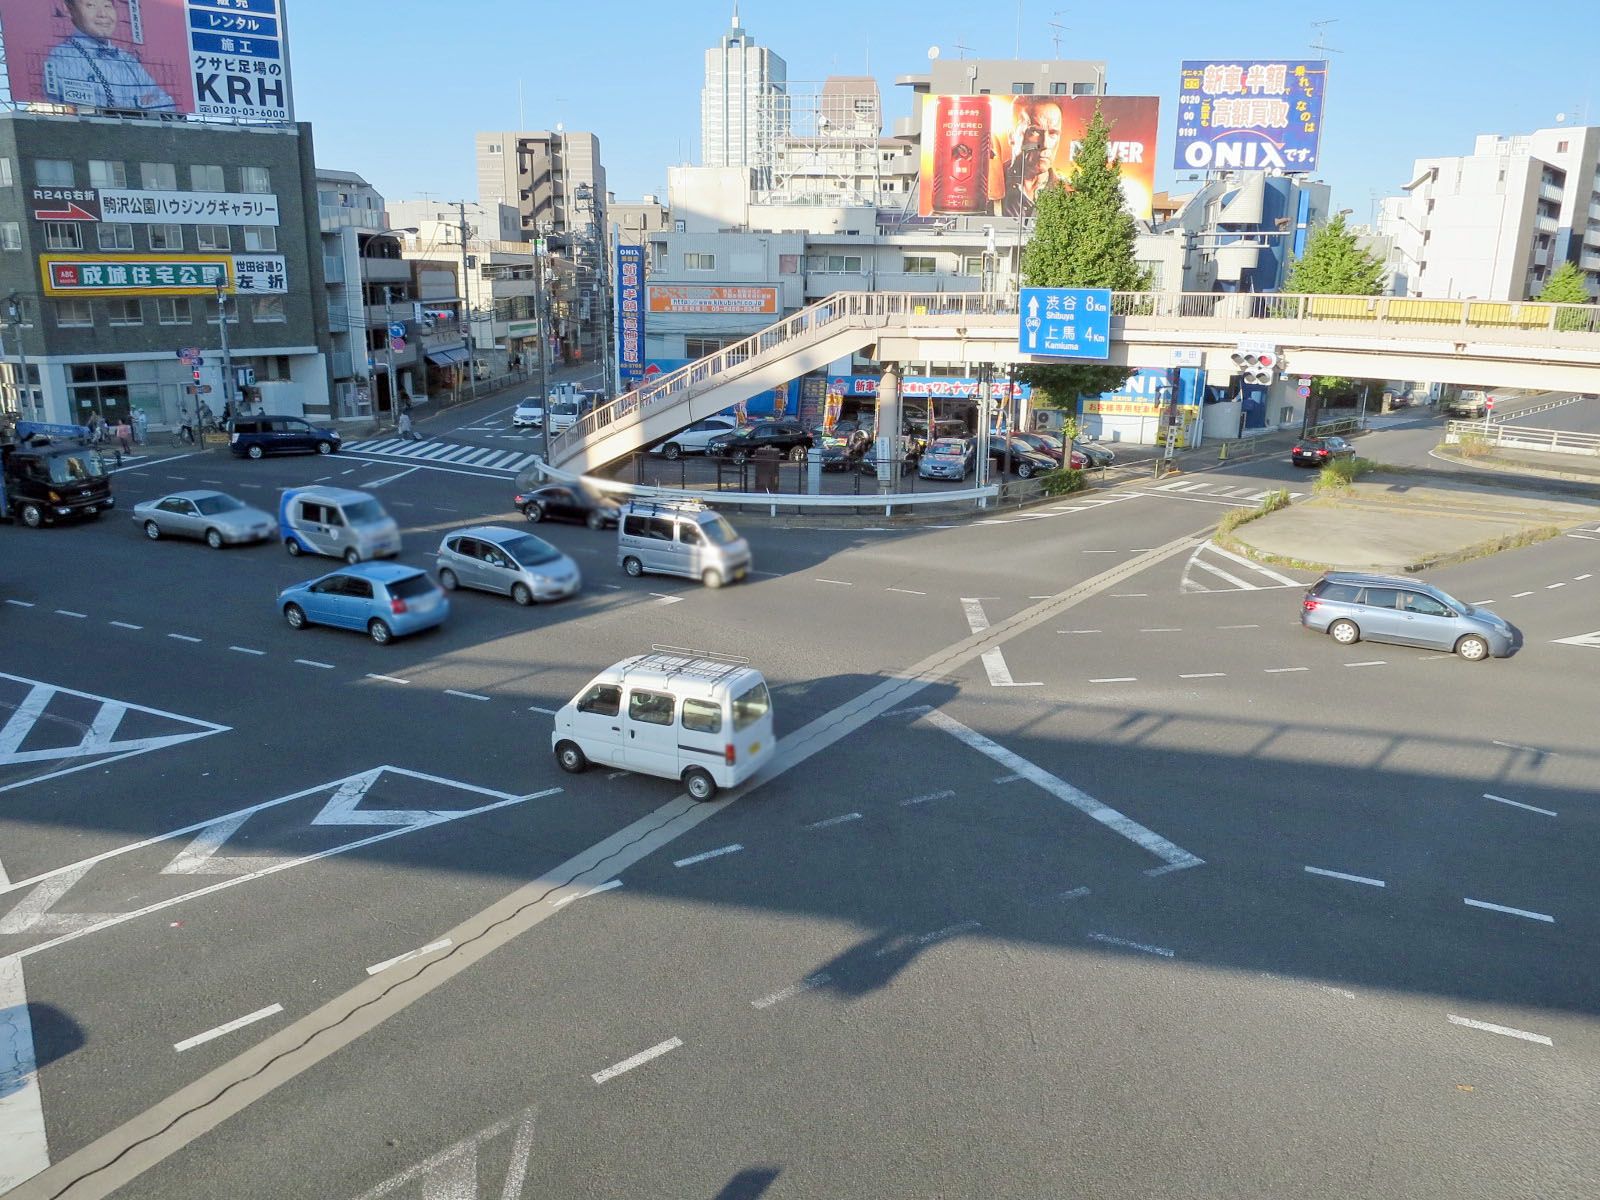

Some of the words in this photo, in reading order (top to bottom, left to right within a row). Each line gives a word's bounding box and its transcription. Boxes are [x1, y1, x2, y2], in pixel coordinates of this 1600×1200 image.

[209, 14, 260, 31] レンタル
[220, 37, 253, 54] 施工
[195, 56, 282, 76] クサビ足場の
[195, 72, 285, 108] KRH
[212, 105, 286, 119] 0120-03-6000
[1184, 141, 1287, 168] ONIX
[1283, 147, 1316, 163] です。
[33, 190, 96, 201] R246右折
[103, 196, 276, 218] 駒沢公園ハウジングギャラリー
[236, 260, 283, 273] 世田谷通り
[237, 274, 284, 289] 左折
[1046, 295, 1077, 311] 渋谷
[1046, 311, 1075, 321] Shibuya
[1045, 325, 1076, 341] 上馬
[1044, 341, 1079, 351] Kamiuma
